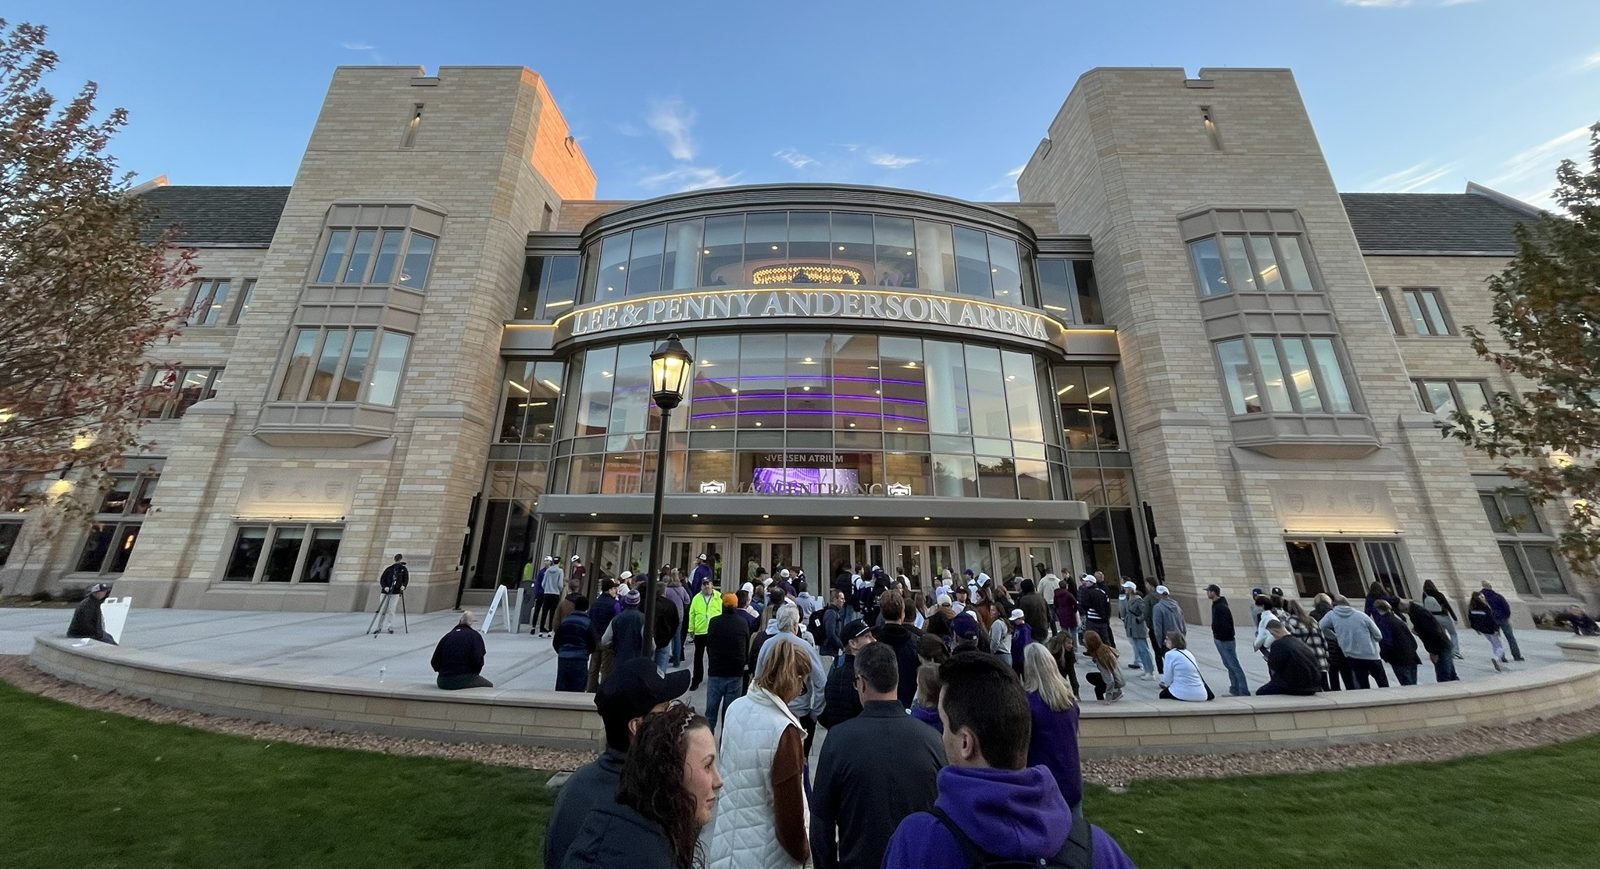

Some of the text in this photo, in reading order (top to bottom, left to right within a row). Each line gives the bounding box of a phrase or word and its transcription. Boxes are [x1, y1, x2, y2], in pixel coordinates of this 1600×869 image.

[571, 305, 618, 336] LEE
[645, 293, 758, 324] PENNY
[760, 292, 951, 324] ANDERSON
[957, 303, 1050, 341] ARENA
[808, 455, 844, 463] ATRIUM
